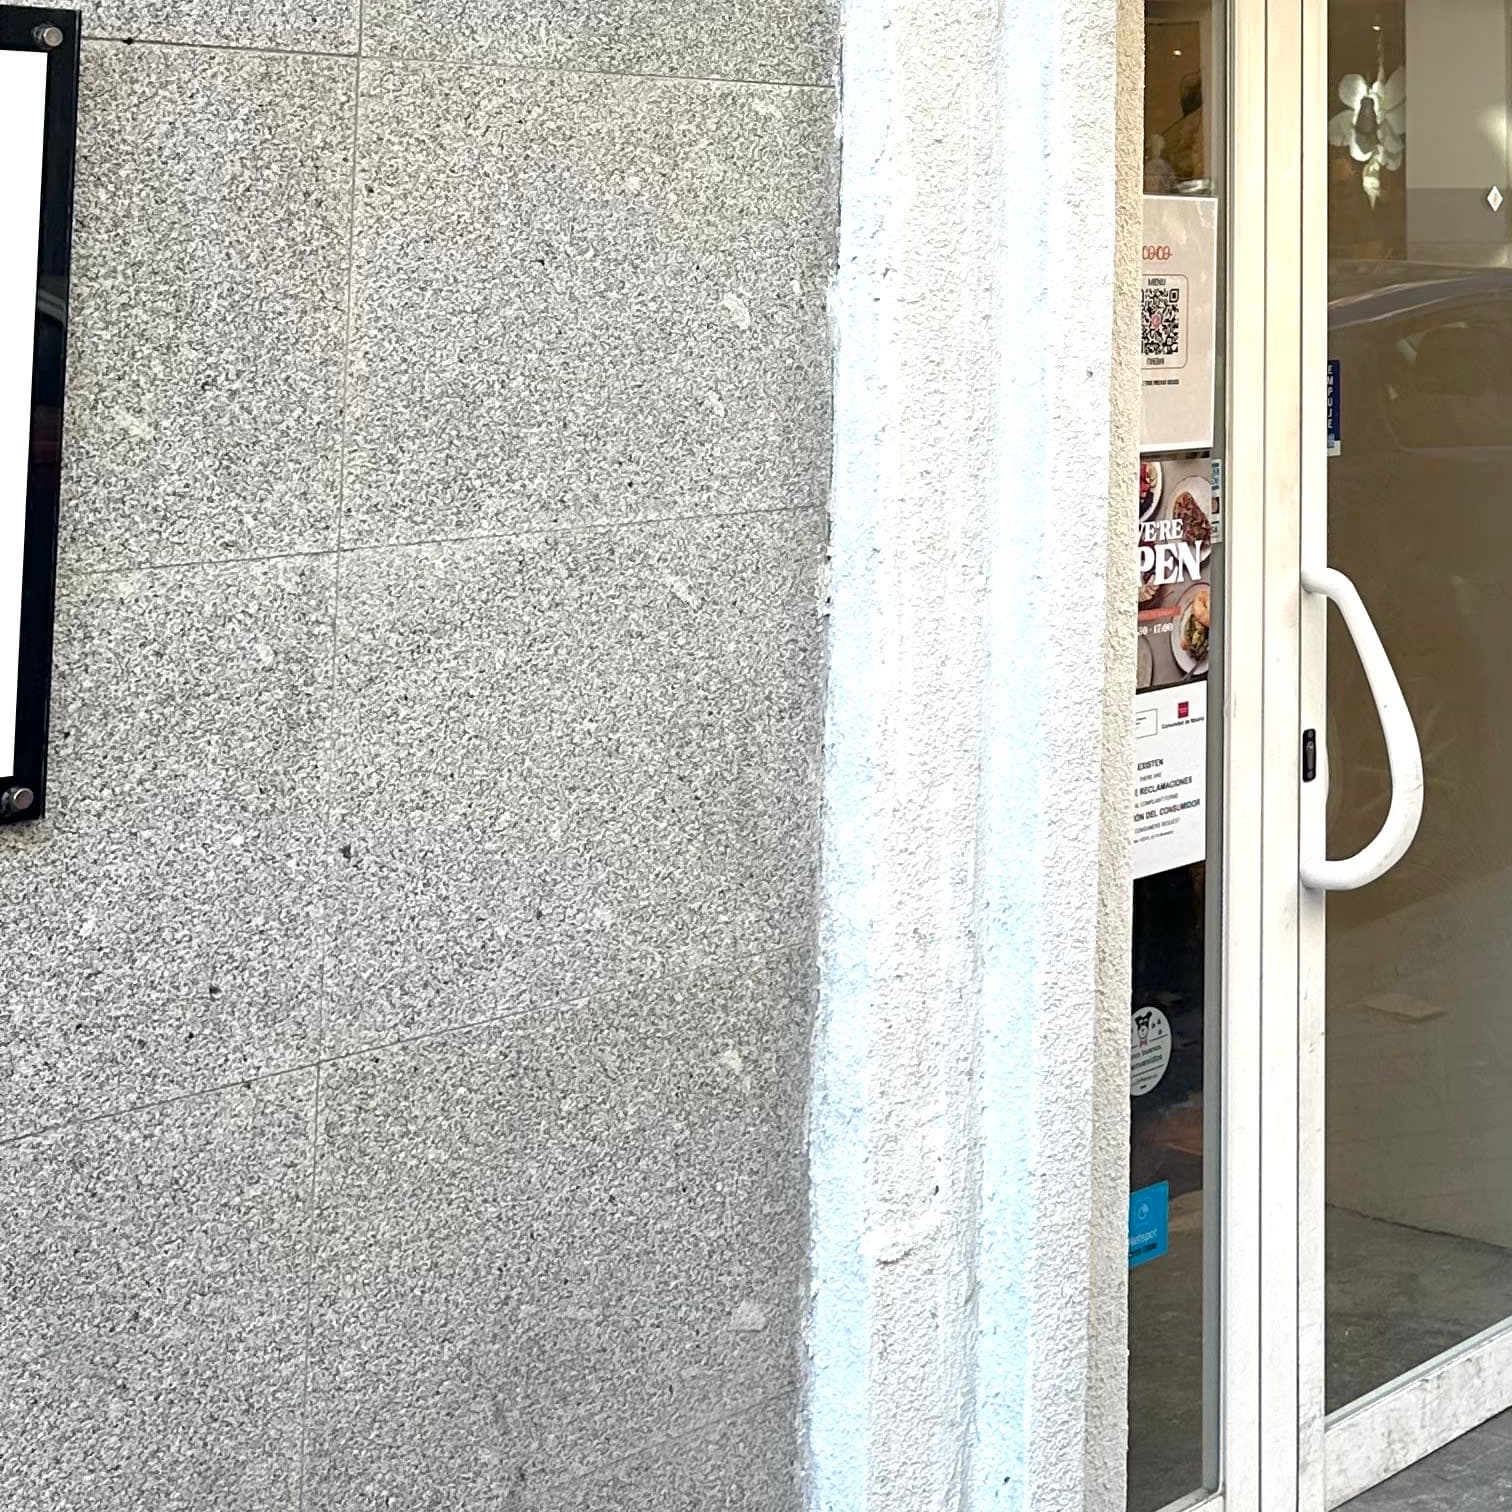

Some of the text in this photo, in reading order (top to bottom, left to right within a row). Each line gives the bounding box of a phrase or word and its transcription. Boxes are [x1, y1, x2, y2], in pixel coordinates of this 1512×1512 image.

[1139, 518, 1184, 542] E'RE
[1138, 540, 1202, 586] PEN
[1137, 758, 1164, 771] EXISTEN
[1139, 775, 1193, 795] RECLAMACIONES
[1133, 798, 1201, 822] IÓN DEL CONSUMIDOR
